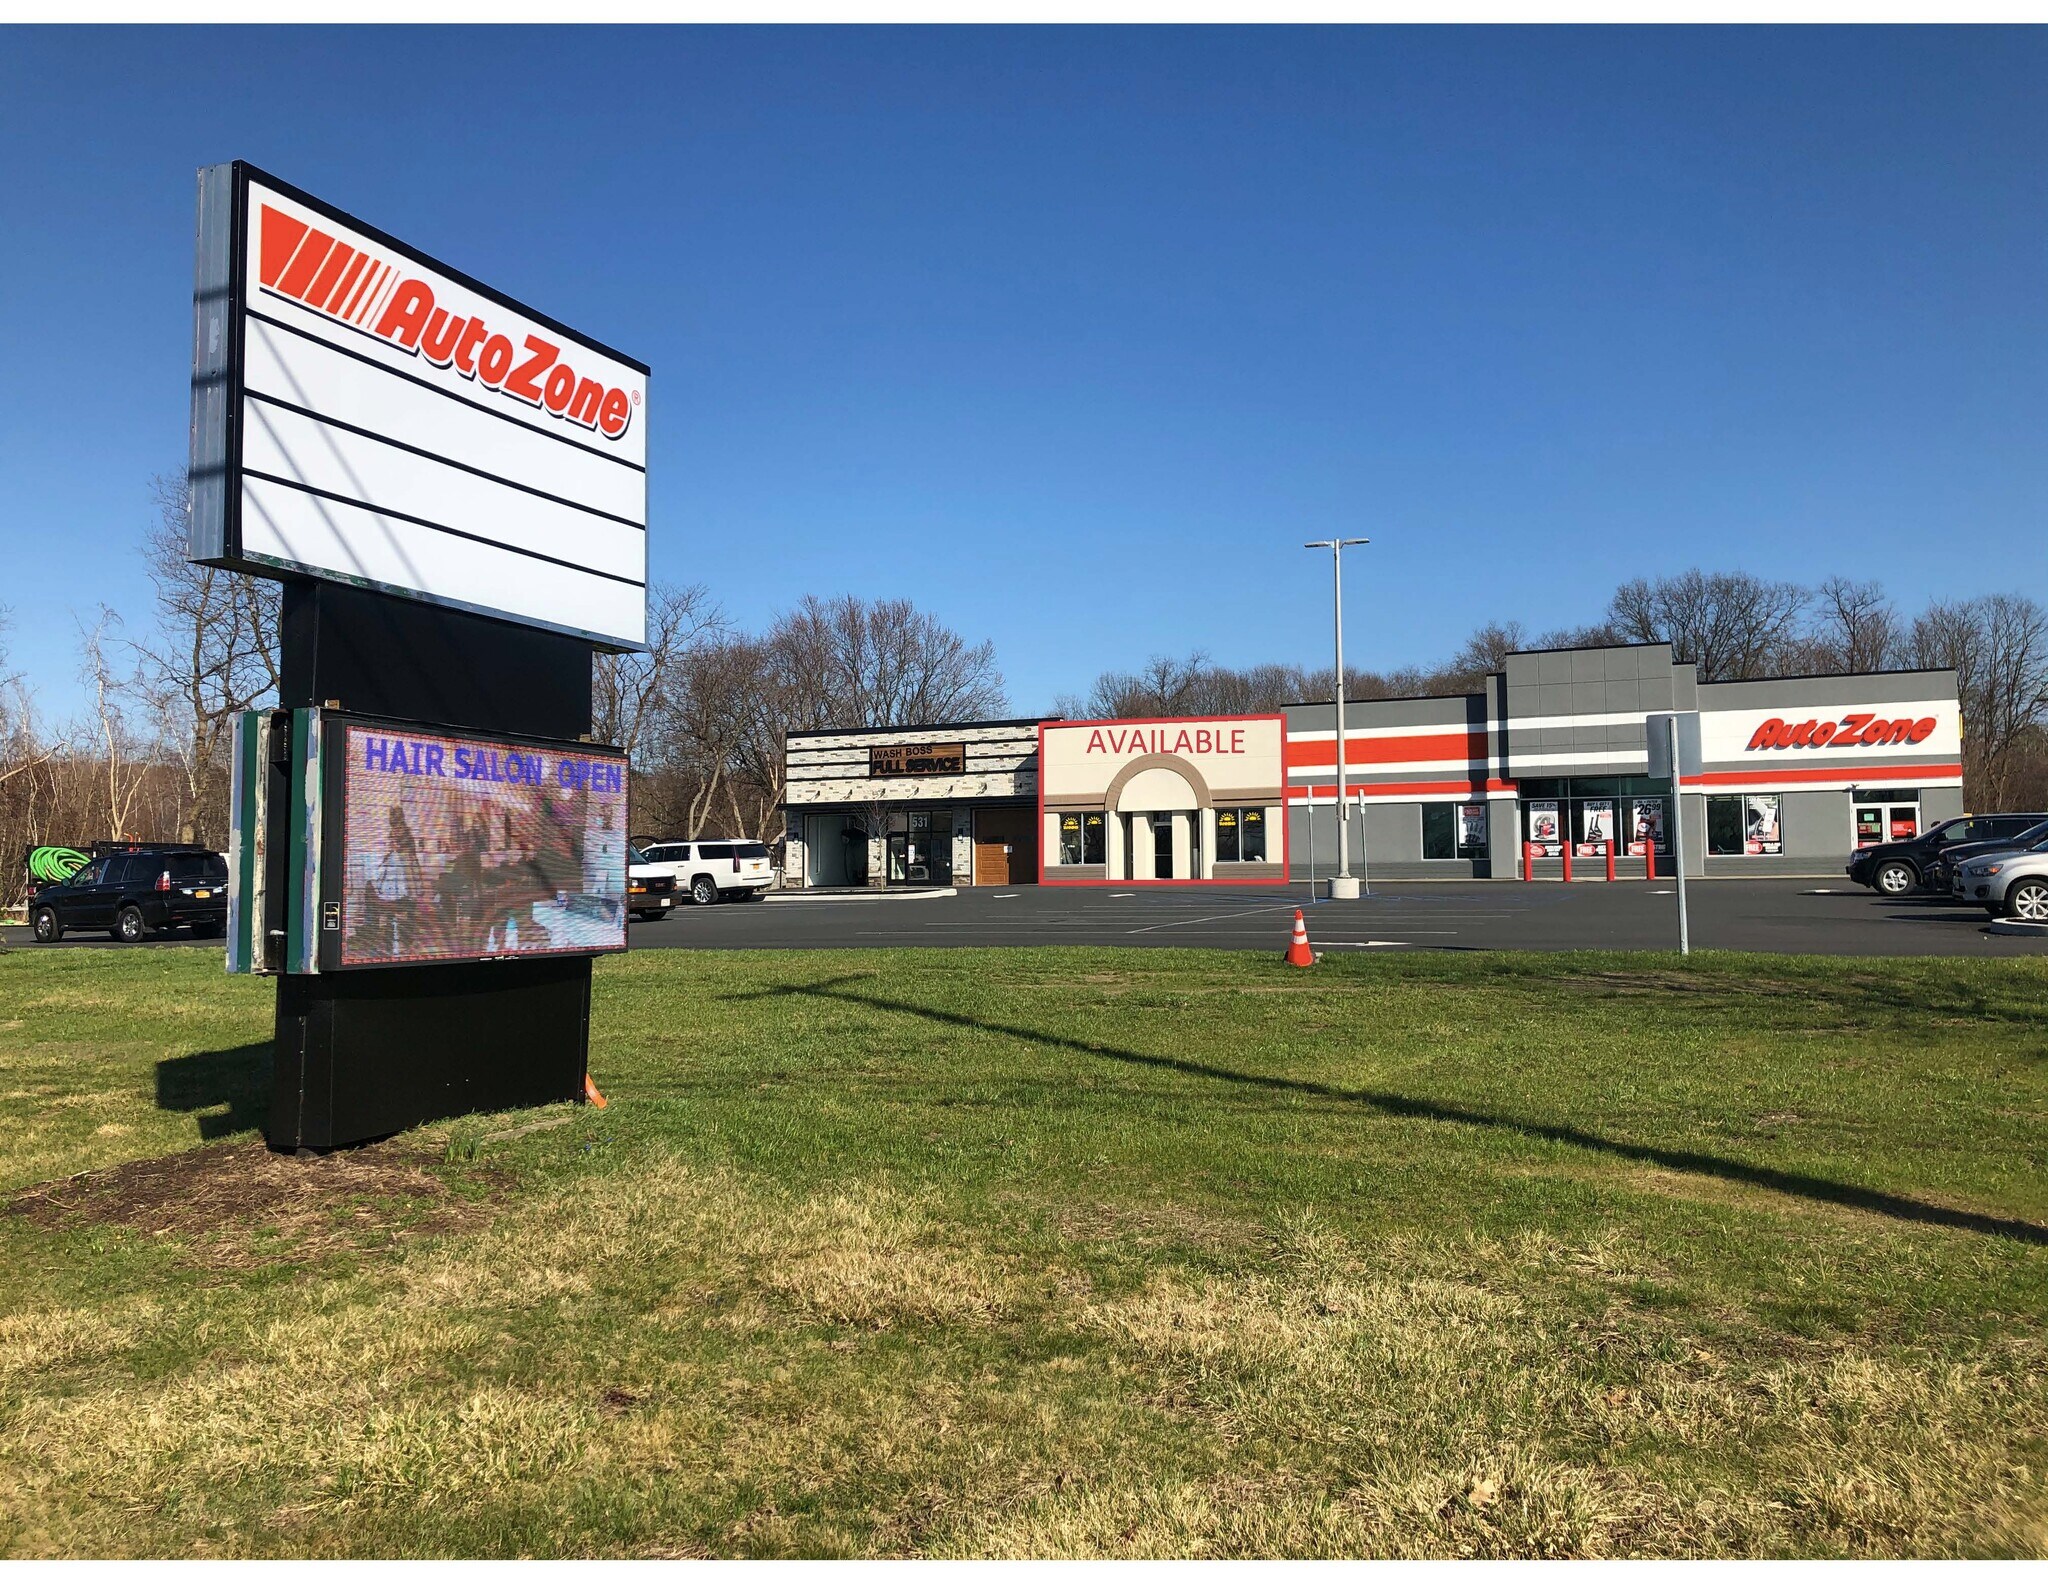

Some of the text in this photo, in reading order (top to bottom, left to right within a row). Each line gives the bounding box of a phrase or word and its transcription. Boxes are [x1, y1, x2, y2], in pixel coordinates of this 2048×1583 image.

[375, 278, 632, 440] AutoZone
[1745, 713, 1938, 751] AutoZone
[365, 736, 622, 793] HAIR SALON OPEN
[873, 745, 933, 760] WASH BOSS
[873, 757, 960, 774] FULL SERVICE
[912, 816, 928, 828] 531
